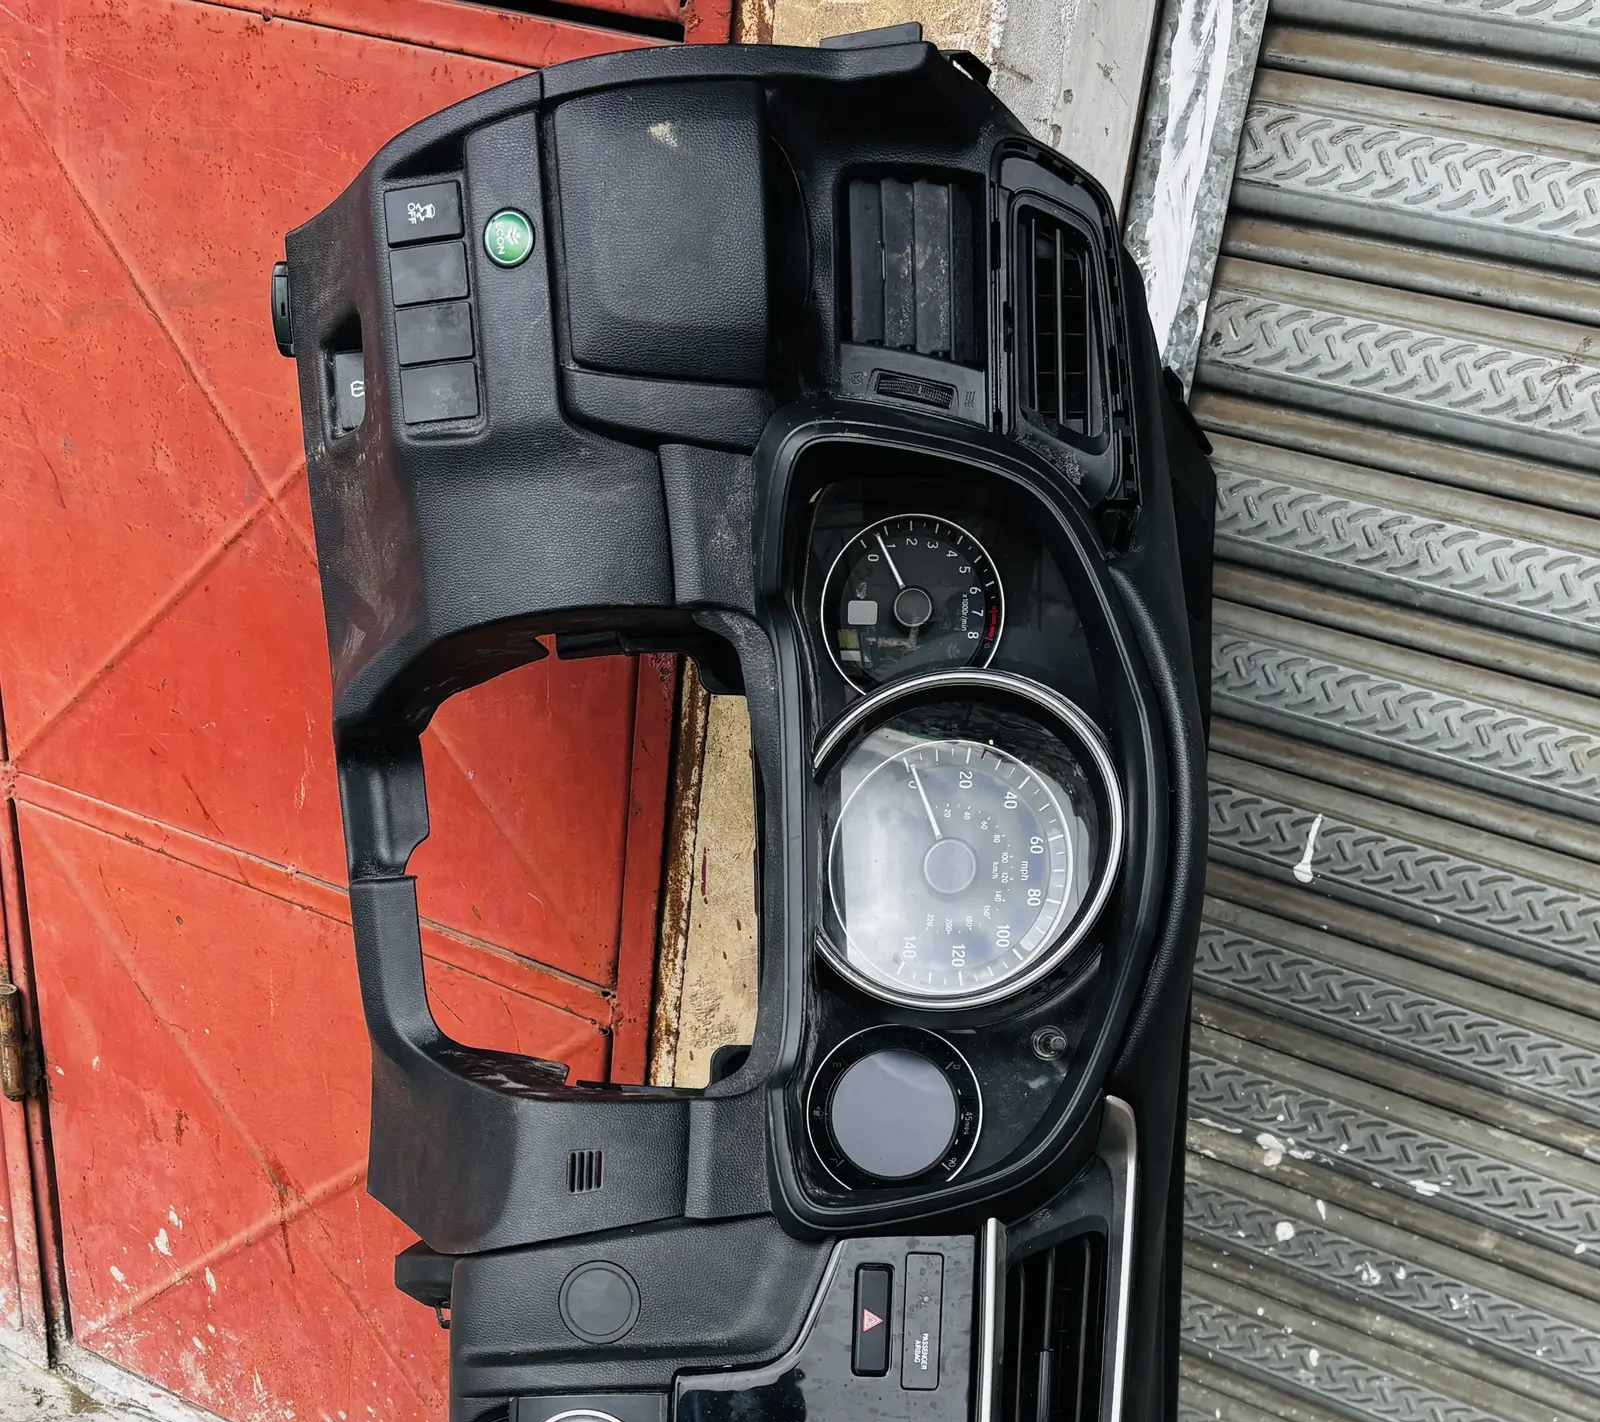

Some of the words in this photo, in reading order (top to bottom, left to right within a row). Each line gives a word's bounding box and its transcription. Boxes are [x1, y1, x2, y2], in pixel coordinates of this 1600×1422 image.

[407, 202, 417, 224] OFF
[495, 222, 506, 254] ECON
[906, 538, 918, 546] 2
[927, 541, 938, 549] 3
[868, 554, 880, 562] 0
[946, 550, 958, 558] 4
[959, 566, 971, 574] 5
[969, 586, 982, 595] 6
[972, 609, 984, 618] 7
[968, 631, 979, 640] 8
[959, 771, 972, 789] 20
[1004, 791, 1018, 810] 40
[944, 808, 952, 818] 20
[964, 810, 971, 820] 40
[980, 820, 988, 830] 60
[994, 834, 1001, 844] 80
[1030, 836, 1044, 854] 60
[992, 862, 1000, 880] km/h
[1020, 860, 1028, 881] mph
[994, 890, 1002, 902] 140
[1027, 888, 1042, 906] 80
[926, 913, 934, 927] 220
[996, 924, 1010, 948] 100
[902, 936, 916, 959] 140
[952, 944, 966, 968] 120
